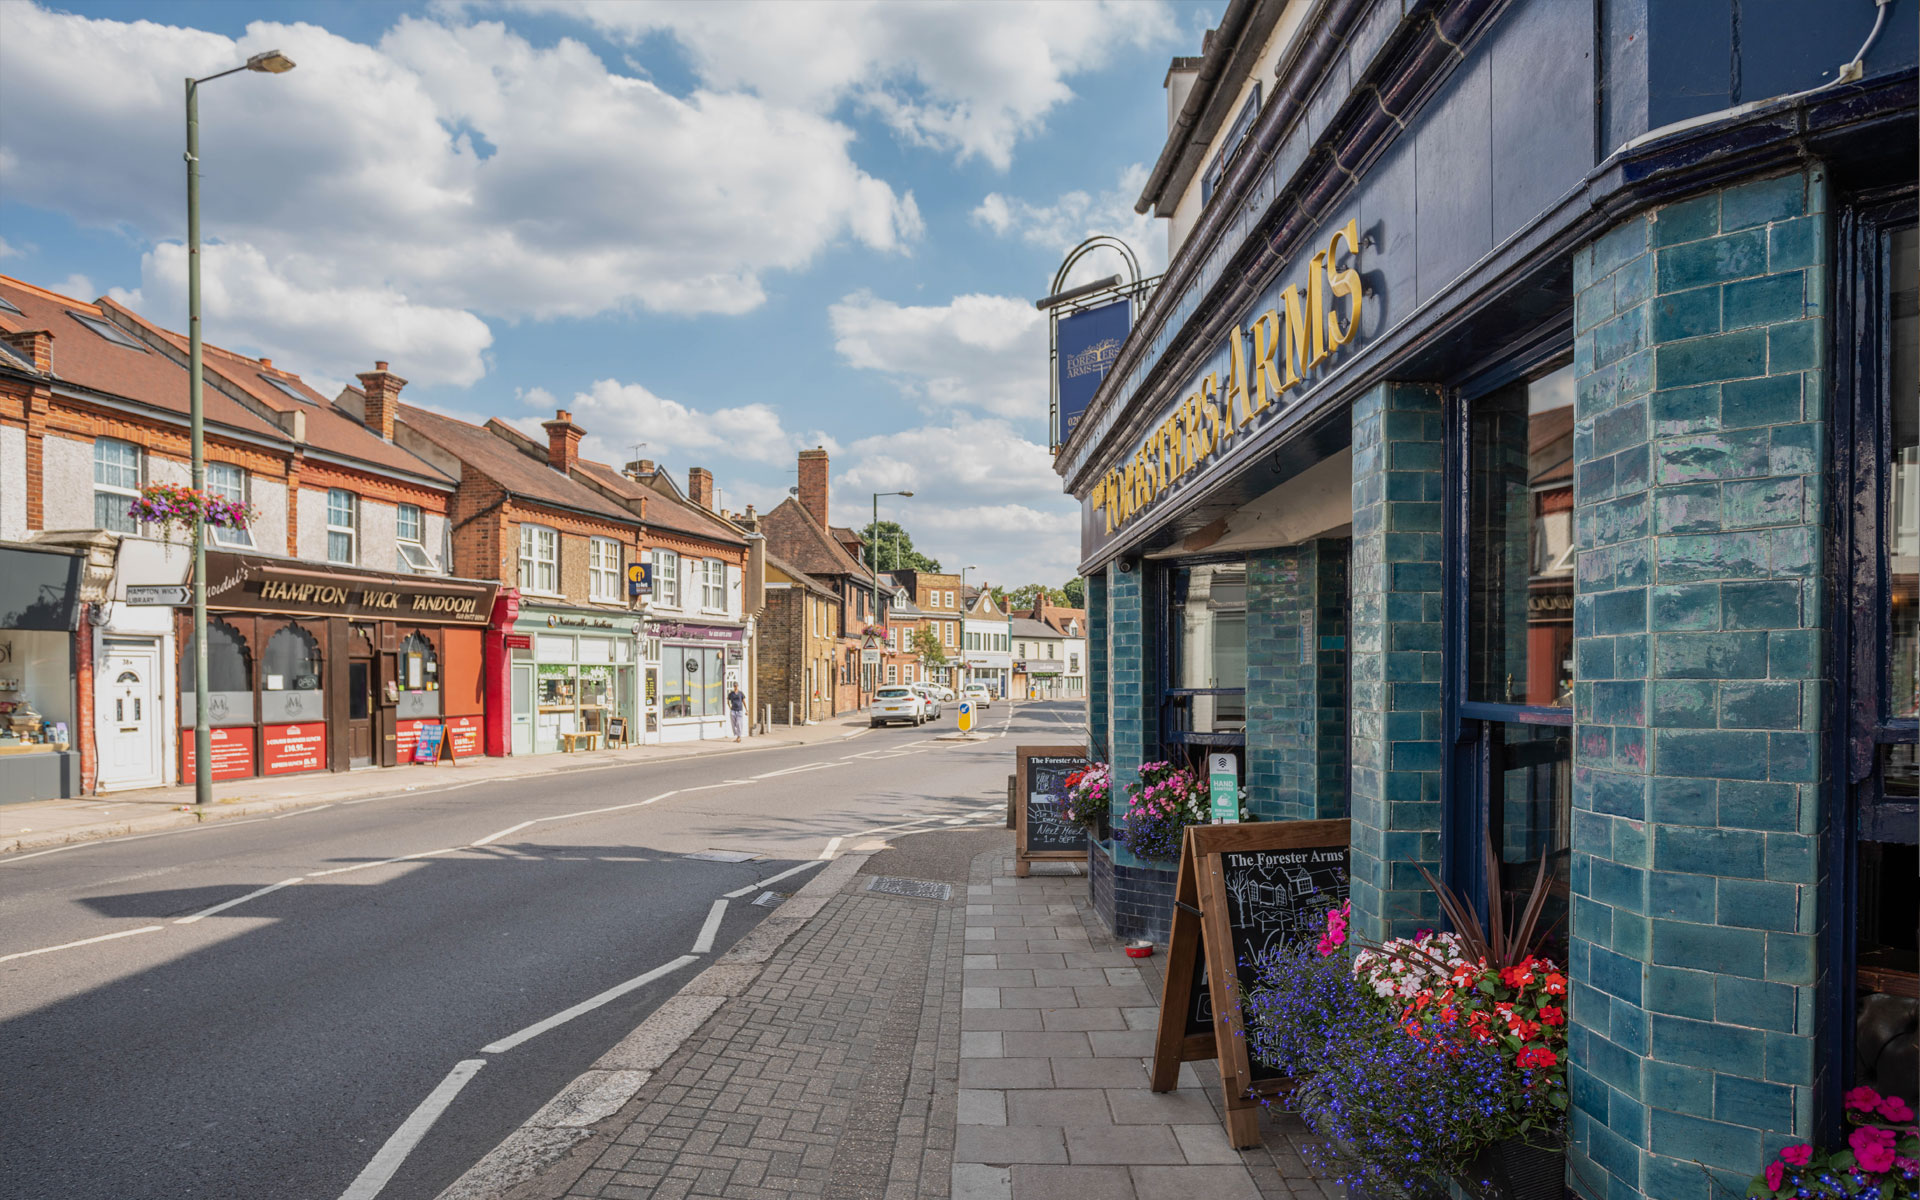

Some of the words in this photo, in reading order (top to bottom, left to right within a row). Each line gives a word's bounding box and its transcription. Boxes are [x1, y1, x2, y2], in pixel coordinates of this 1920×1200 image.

[1067, 346, 1121, 370] FORESTERS
[1067, 364, 1092, 379] ARMS
[1104, 371, 1219, 536] FORESTERS
[1223, 218, 1362, 440] ARMS
[261, 580, 349, 604] HAMPTON
[362, 590, 400, 609] WICK
[412, 594, 477, 613] TANDOORI
[1036, 824, 1059, 835] Next
[1228, 854, 1254, 867] The
[1256, 852, 1308, 866] Forester
[1311, 849, 1344, 863] Arms
